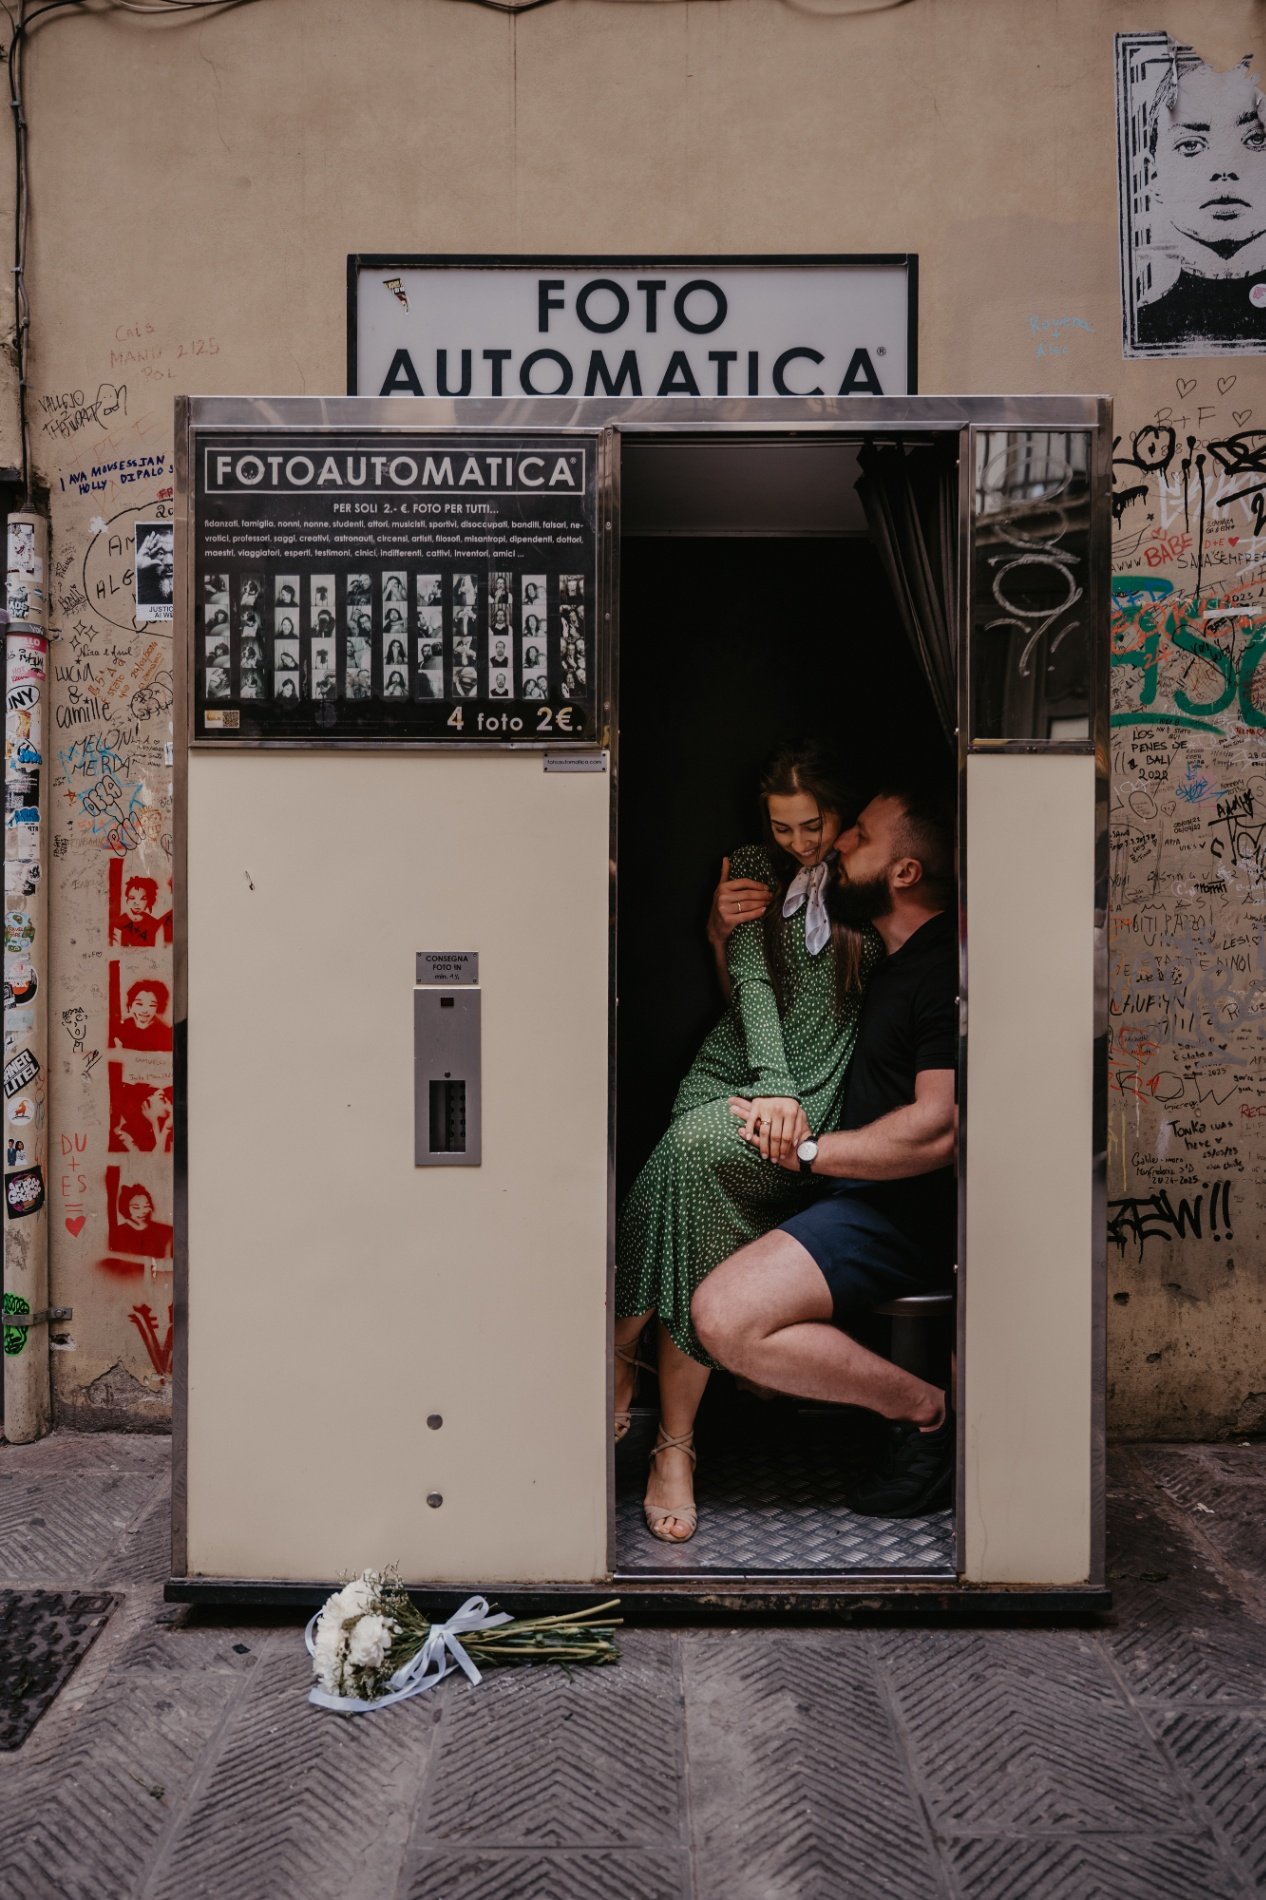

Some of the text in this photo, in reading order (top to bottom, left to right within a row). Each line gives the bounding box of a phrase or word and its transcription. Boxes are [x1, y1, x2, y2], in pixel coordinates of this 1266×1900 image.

[538, 279, 728, 334] FOTO
[333, 503, 351, 513] PER
[354, 503, 378, 513] SOLI
[412, 503, 441, 514] FOTO
[444, 503, 463, 514] PER
[465, 503, 499, 514] TUTTI...
[1144, 532, 1193, 567] BABE
[447, 706, 464, 731] 4
[477, 713, 524, 731] foto
[1131, 741, 1168, 752] PENES
[1132, 730, 1155, 741] LOS
[72, 754, 132, 778] MERDA
[432, 963, 462, 971] FOTO IN
[61, 1133, 88, 1155] DU
[61, 1174, 88, 1197] ES
